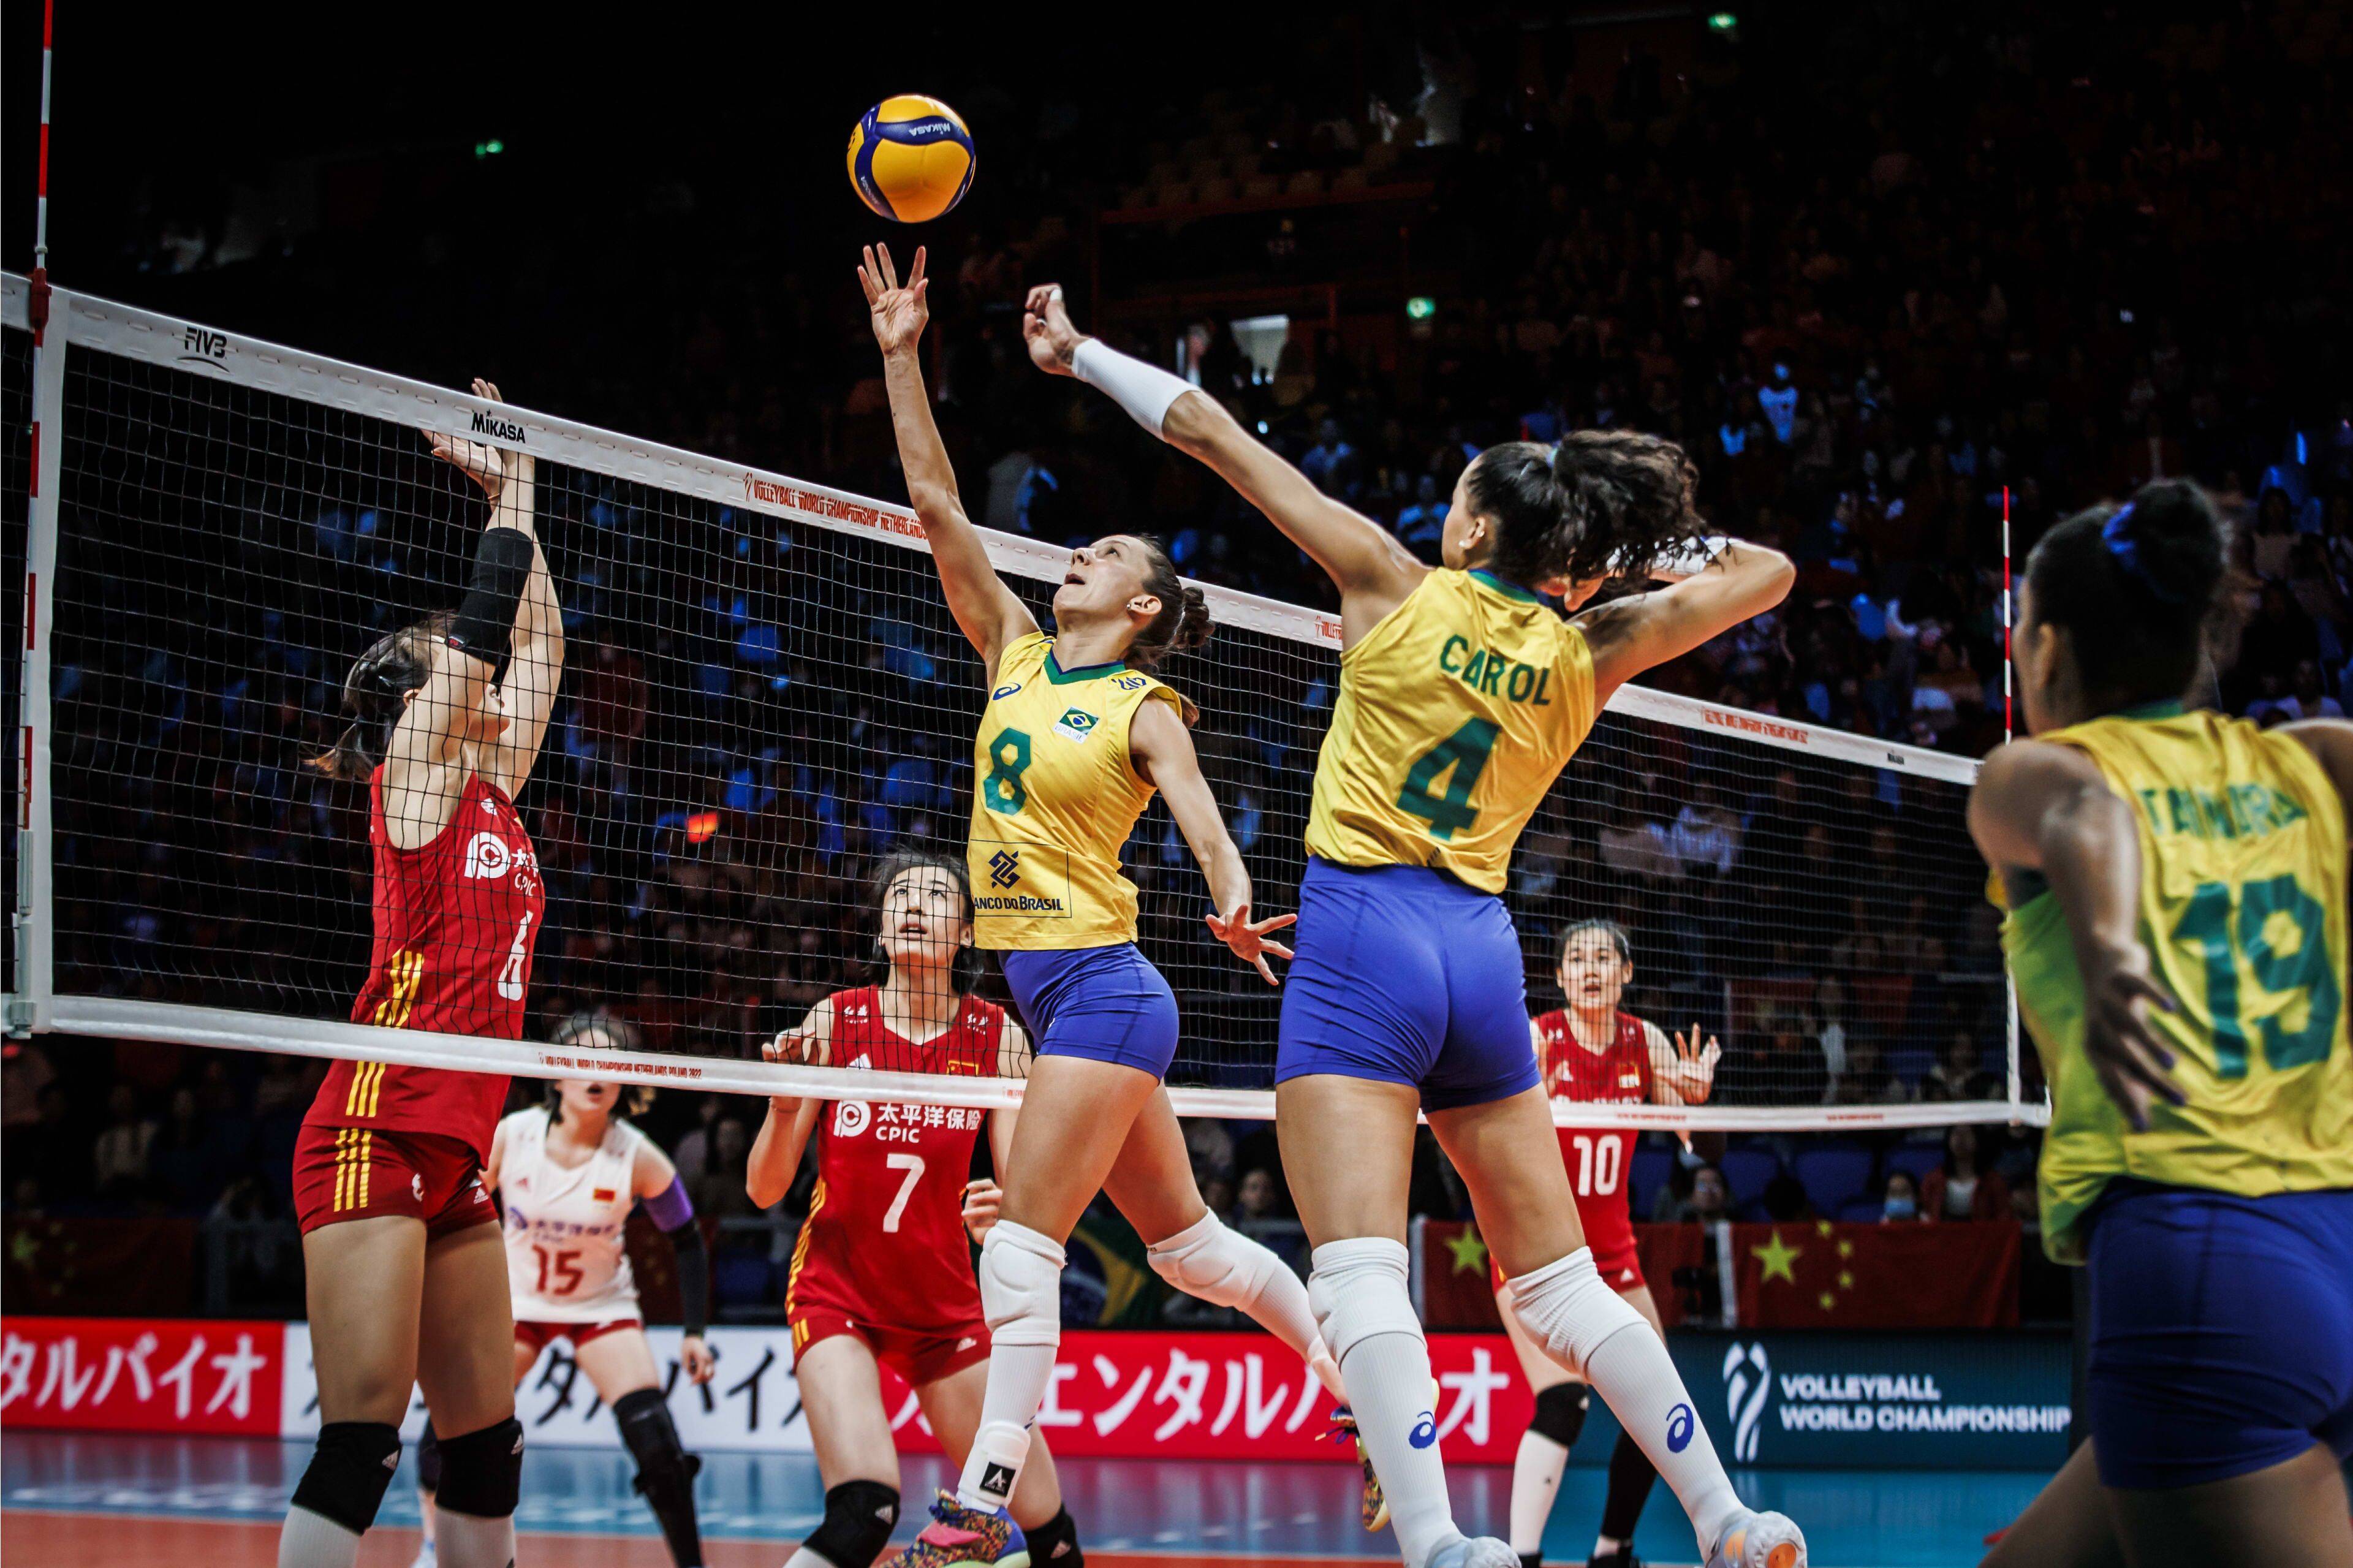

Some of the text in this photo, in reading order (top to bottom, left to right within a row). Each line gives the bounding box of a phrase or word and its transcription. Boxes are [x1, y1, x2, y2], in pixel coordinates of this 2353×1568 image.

[909, 123, 951, 136] MIKASA
[184, 327, 227, 358] FIVB
[471, 409, 526, 444] MIKASA
[754, 480, 796, 508] VOLLEYBALL
[798, 491, 825, 515] WORLD
[826, 498, 879, 528] CHAMPIONSHIP
[1439, 634, 1551, 706] CAROL
[983, 727, 1031, 816] 8
[1396, 718, 1500, 842] 4
[974, 897, 1002, 910] ANCO
[1019, 896, 1064, 911] BRASIL
[2170, 874, 2341, 1077] 19
[876, 1126, 920, 1143] CPIC
[877, 1102, 981, 1131] 太平洋保险
[1573, 1135, 1622, 1197] 10
[883, 1153, 925, 1233] 7
[532, 1243, 585, 1297] 15
[1779, 1374, 1941, 1401] VOLLEYBALL
[1779, 1405, 2072, 1433] WORLD CHAMPIONSHIP
